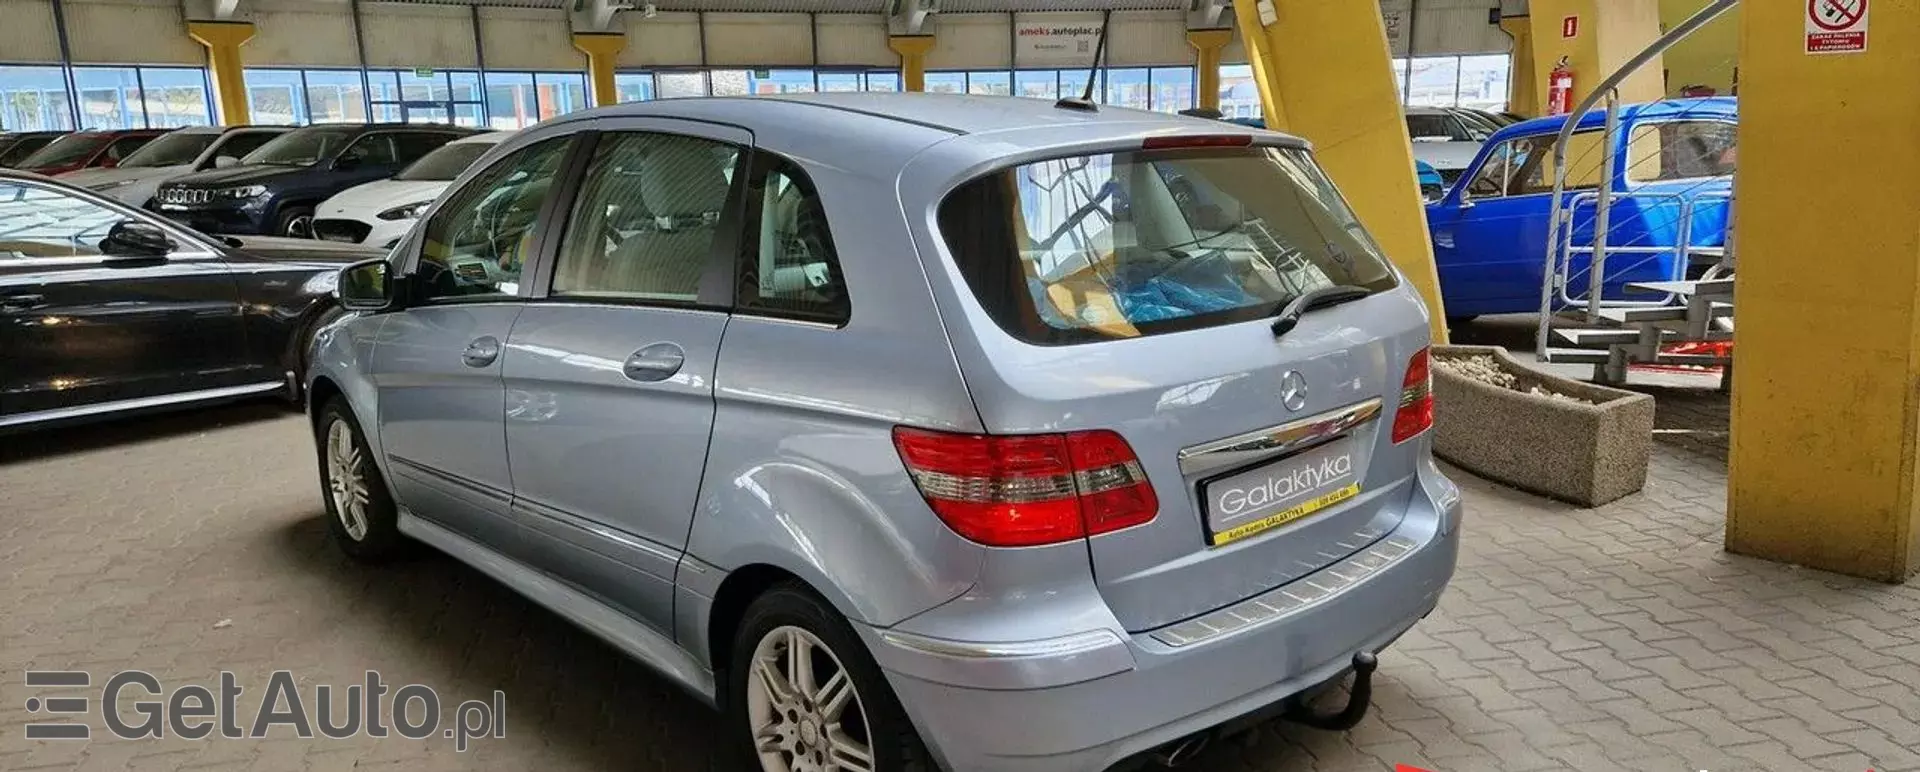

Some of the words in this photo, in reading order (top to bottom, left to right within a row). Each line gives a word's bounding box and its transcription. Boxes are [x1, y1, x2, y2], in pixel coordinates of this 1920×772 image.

[1018, 26, 1103, 37] ameks.autoplac.p
[1219, 453, 1351, 515] Galaktyka
[1265, 507, 1304, 526] GALAKTYKA
